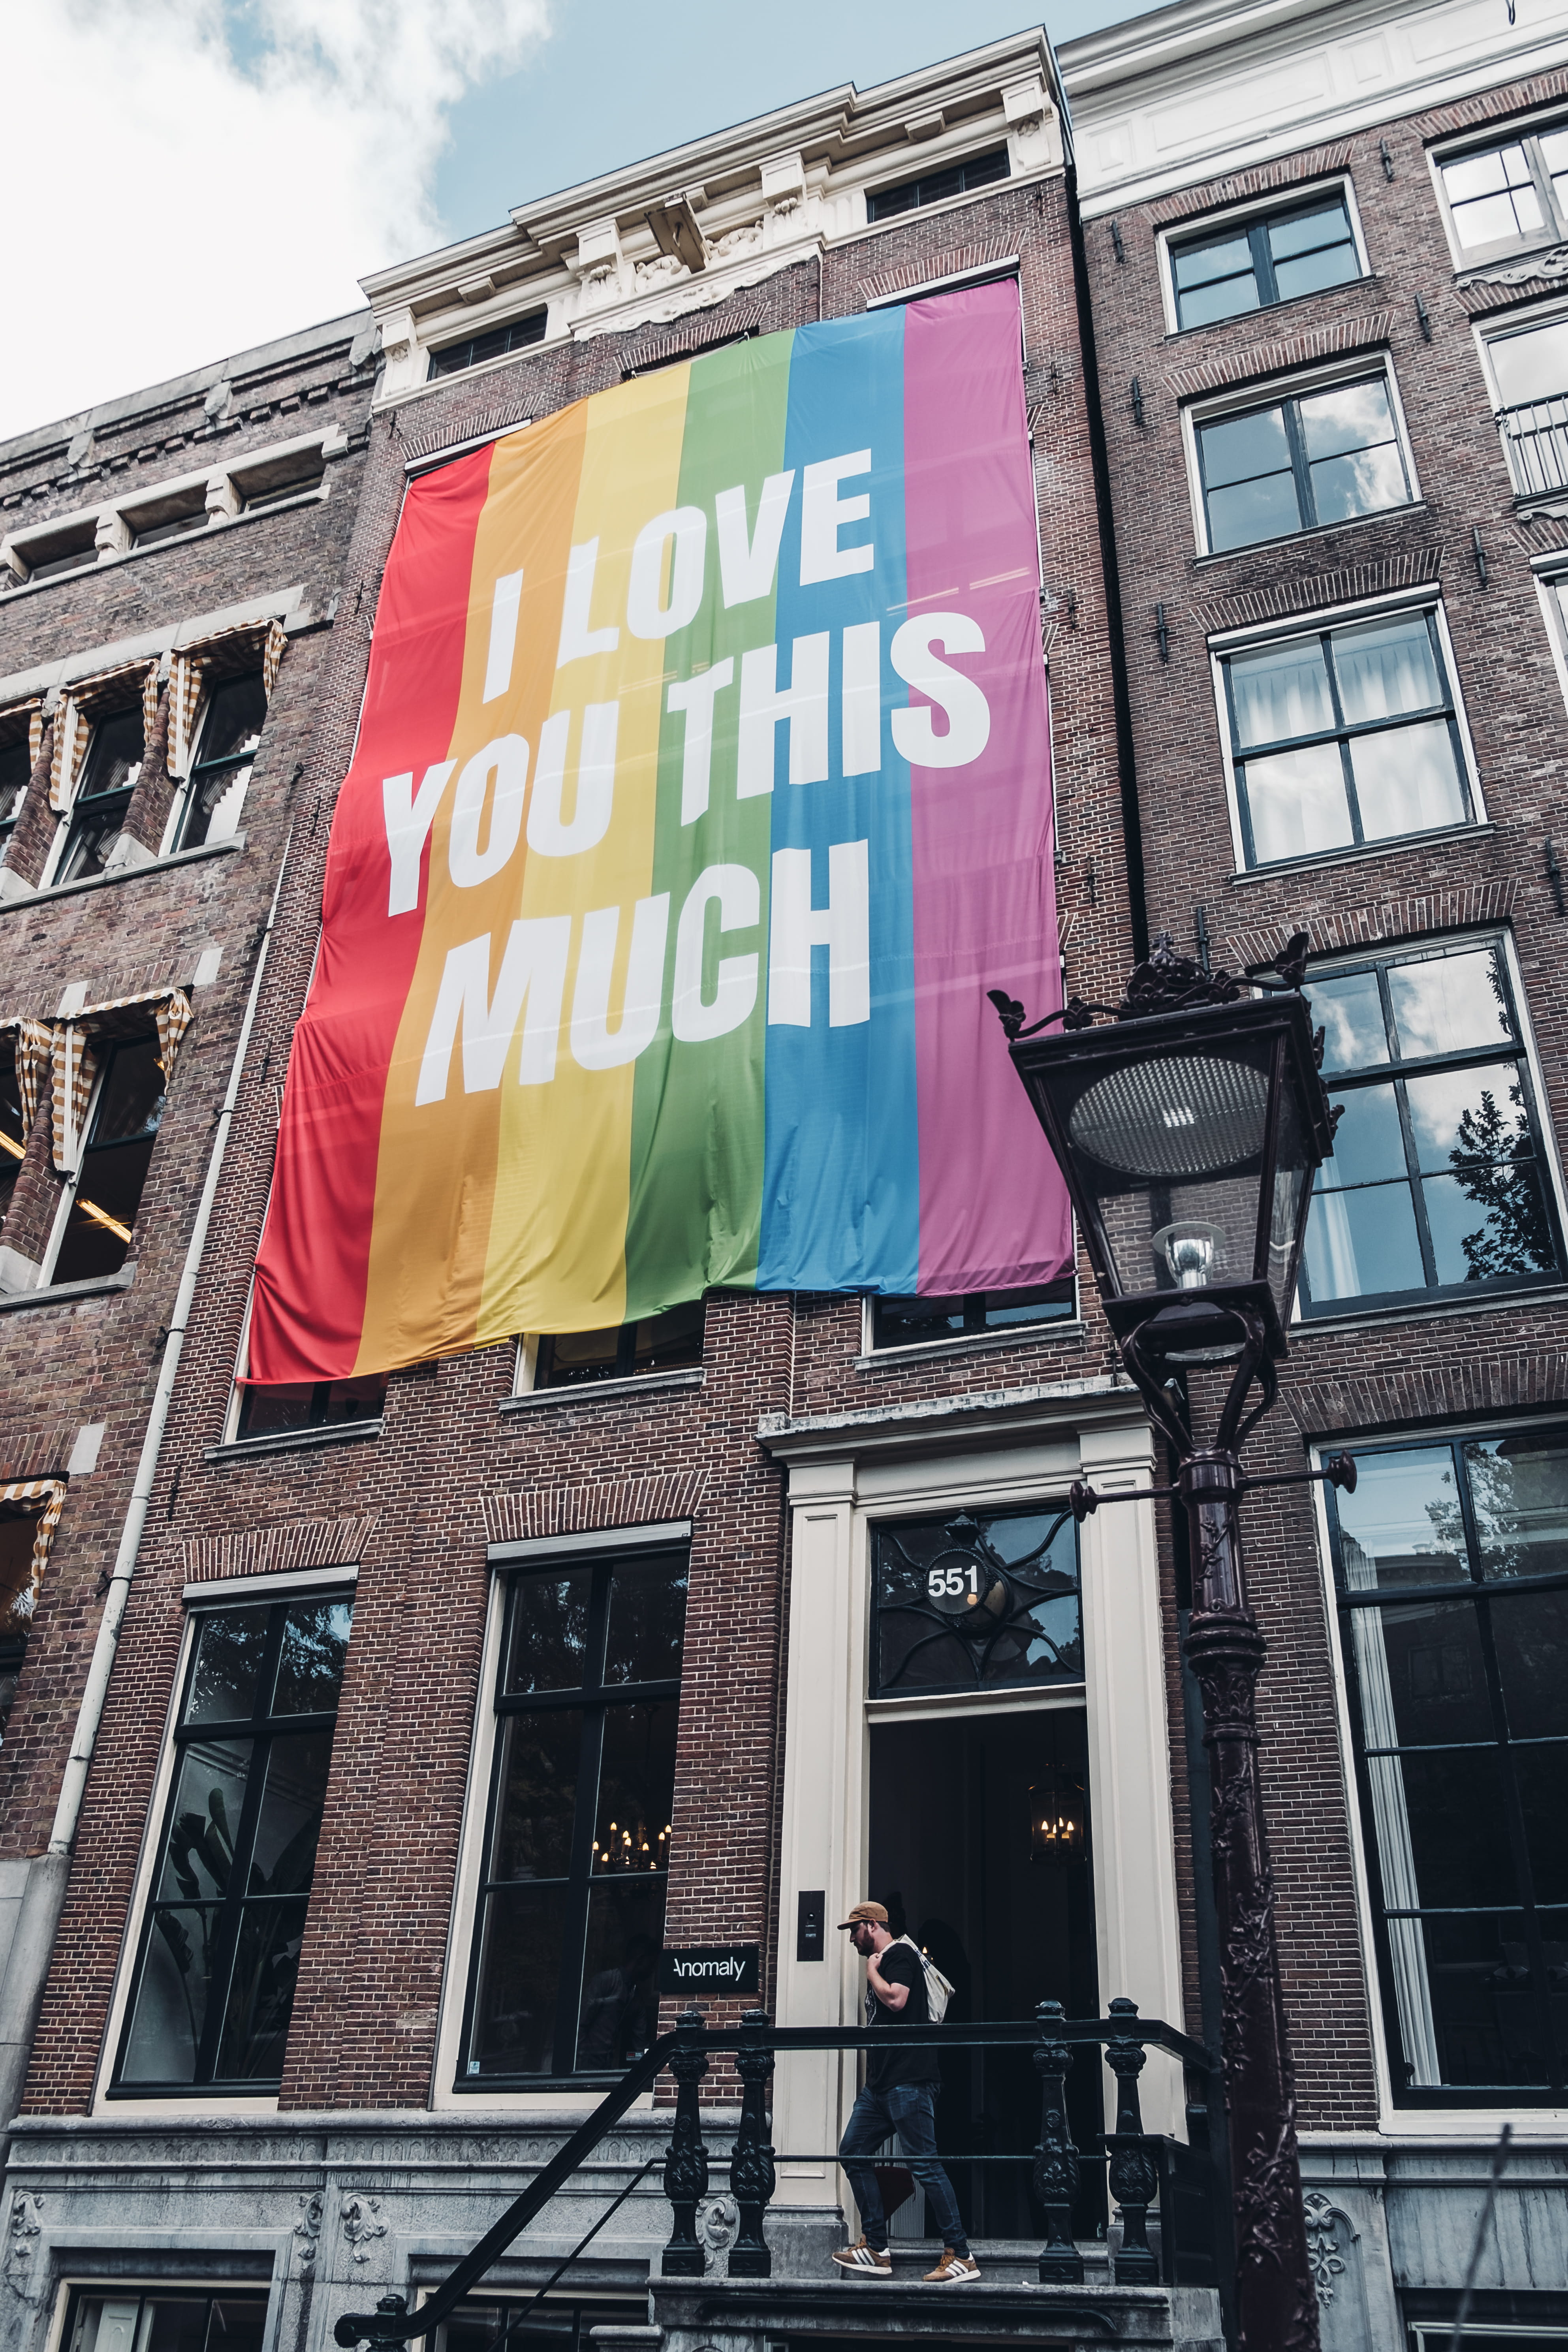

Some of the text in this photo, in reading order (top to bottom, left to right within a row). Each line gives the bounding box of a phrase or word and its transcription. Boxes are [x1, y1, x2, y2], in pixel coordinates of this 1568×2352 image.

[483, 448, 874, 704] I LOVE
[382, 611, 991, 917] YOU THIS
[415, 839, 870, 1107] MUCH
[928, 1565, 978, 1597] 551
[673, 1956, 746, 1981] Anomaly
